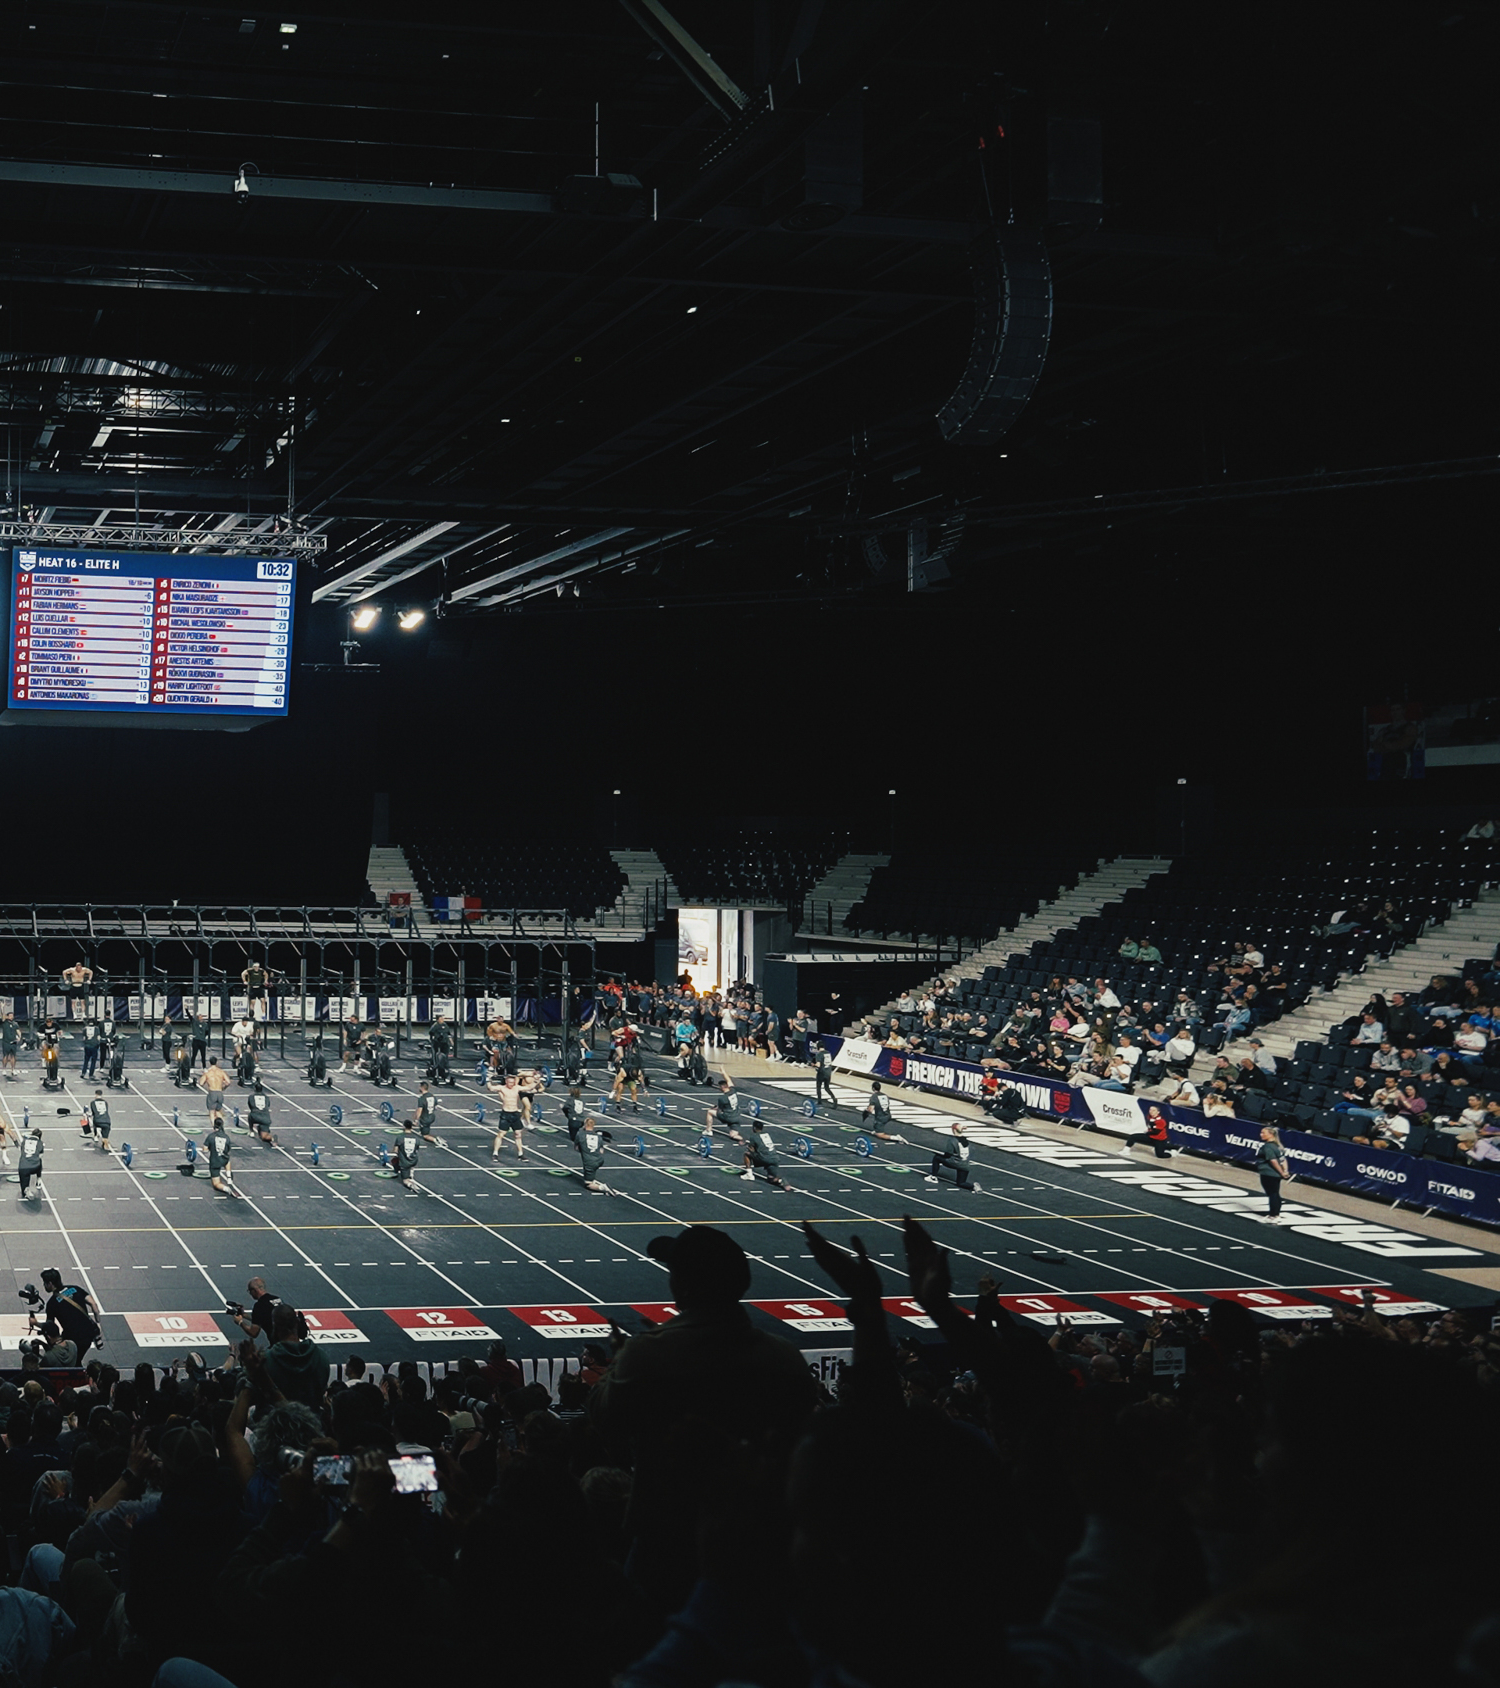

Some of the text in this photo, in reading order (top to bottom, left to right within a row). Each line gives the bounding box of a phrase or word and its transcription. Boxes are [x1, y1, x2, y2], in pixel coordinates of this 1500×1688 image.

[39, 558, 63, 567] HEAT
[66, 558, 76, 568] 16
[85, 559, 110, 569] ELITE
[113, 560, 119, 569] H
[262, 563, 289, 576] 10:32
[170, 644, 188, 652] VICTOR
[51, 666, 79, 674] GUILLAUME
[906, 1059, 954, 1088] FRENCH
[1103, 1104, 1132, 1118] CrossFit
[1169, 1121, 1210, 1138] ROGUE
[1225, 1134, 1265, 1150] VELITES
[1356, 1163, 1407, 1184] GOWOD
[1428, 1180, 1476, 1200] FITAID
[784, 1304, 824, 1316] 15
[1016, 1299, 1054, 1310] 17
[415, 1312, 454, 1325] 12
[540, 1309, 577, 1322] 13
[155, 1316, 188, 1330] 10
[144, 1335, 220, 1344] FITAID
[415, 1328, 489, 1338] FITAID
